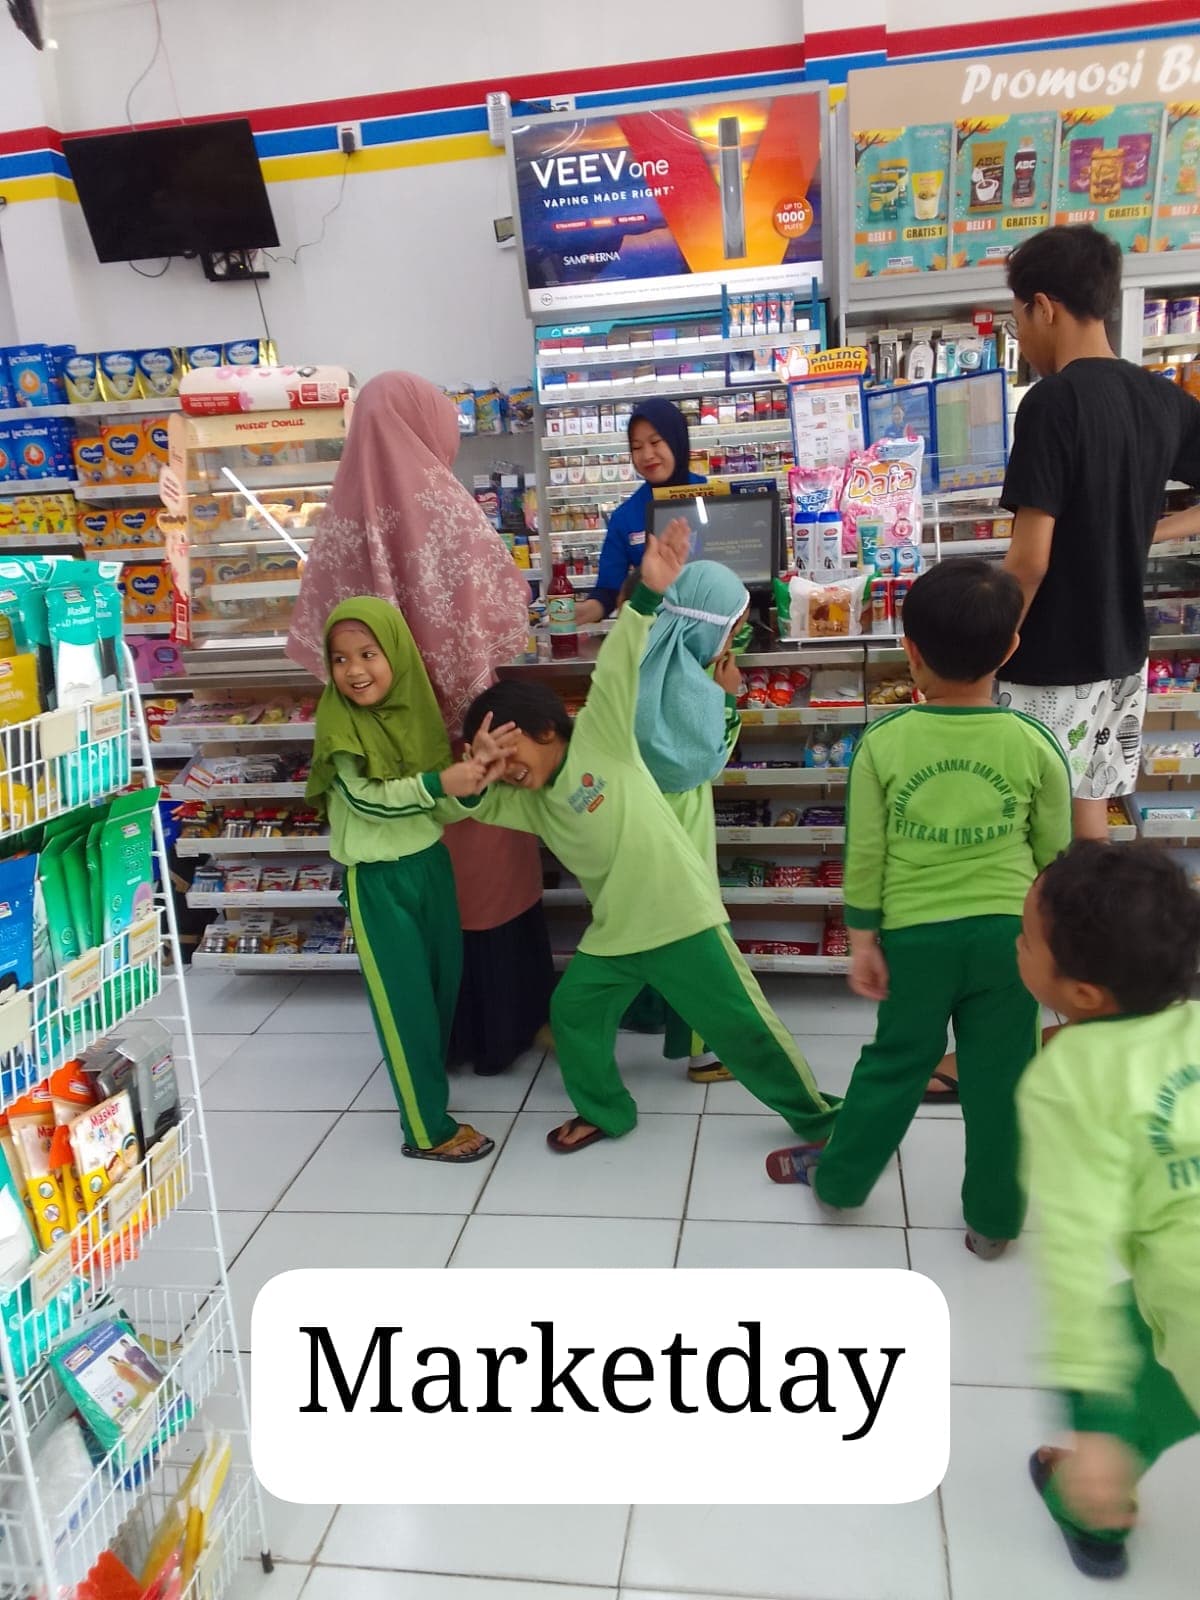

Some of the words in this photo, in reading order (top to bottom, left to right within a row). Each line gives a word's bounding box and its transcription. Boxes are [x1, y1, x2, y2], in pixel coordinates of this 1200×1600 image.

[960, 48, 1146, 105] Promosi
[1157, 44, 1200, 93] B
[975, 156, 1002, 167] ABC
[1015, 159, 1036, 170] ABC
[530, 151, 627, 189] VEEV
[629, 159, 670, 179] one
[543, 195, 589, 208] VAPING
[593, 191, 627, 203] MADE
[1068, 212, 1086, 223] BELI
[1088, 211, 1096, 221] 2
[1108, 207, 1141, 219] GRATIS
[966, 220, 984, 231] BELI
[985, 219, 992, 230] 1
[1006, 217, 1037, 228] GRATIS
[1039, 216, 1045, 226] 1
[906, 227, 937, 239] GRATIS
[938, 226, 943, 236] 1
[811, 350, 863, 365] PALING
[813, 360, 863, 373] MURAH
[849, 464, 917, 498] Daia
[895, 819, 948, 844] FITRAH
[38, 1125, 55, 1138] Mas
